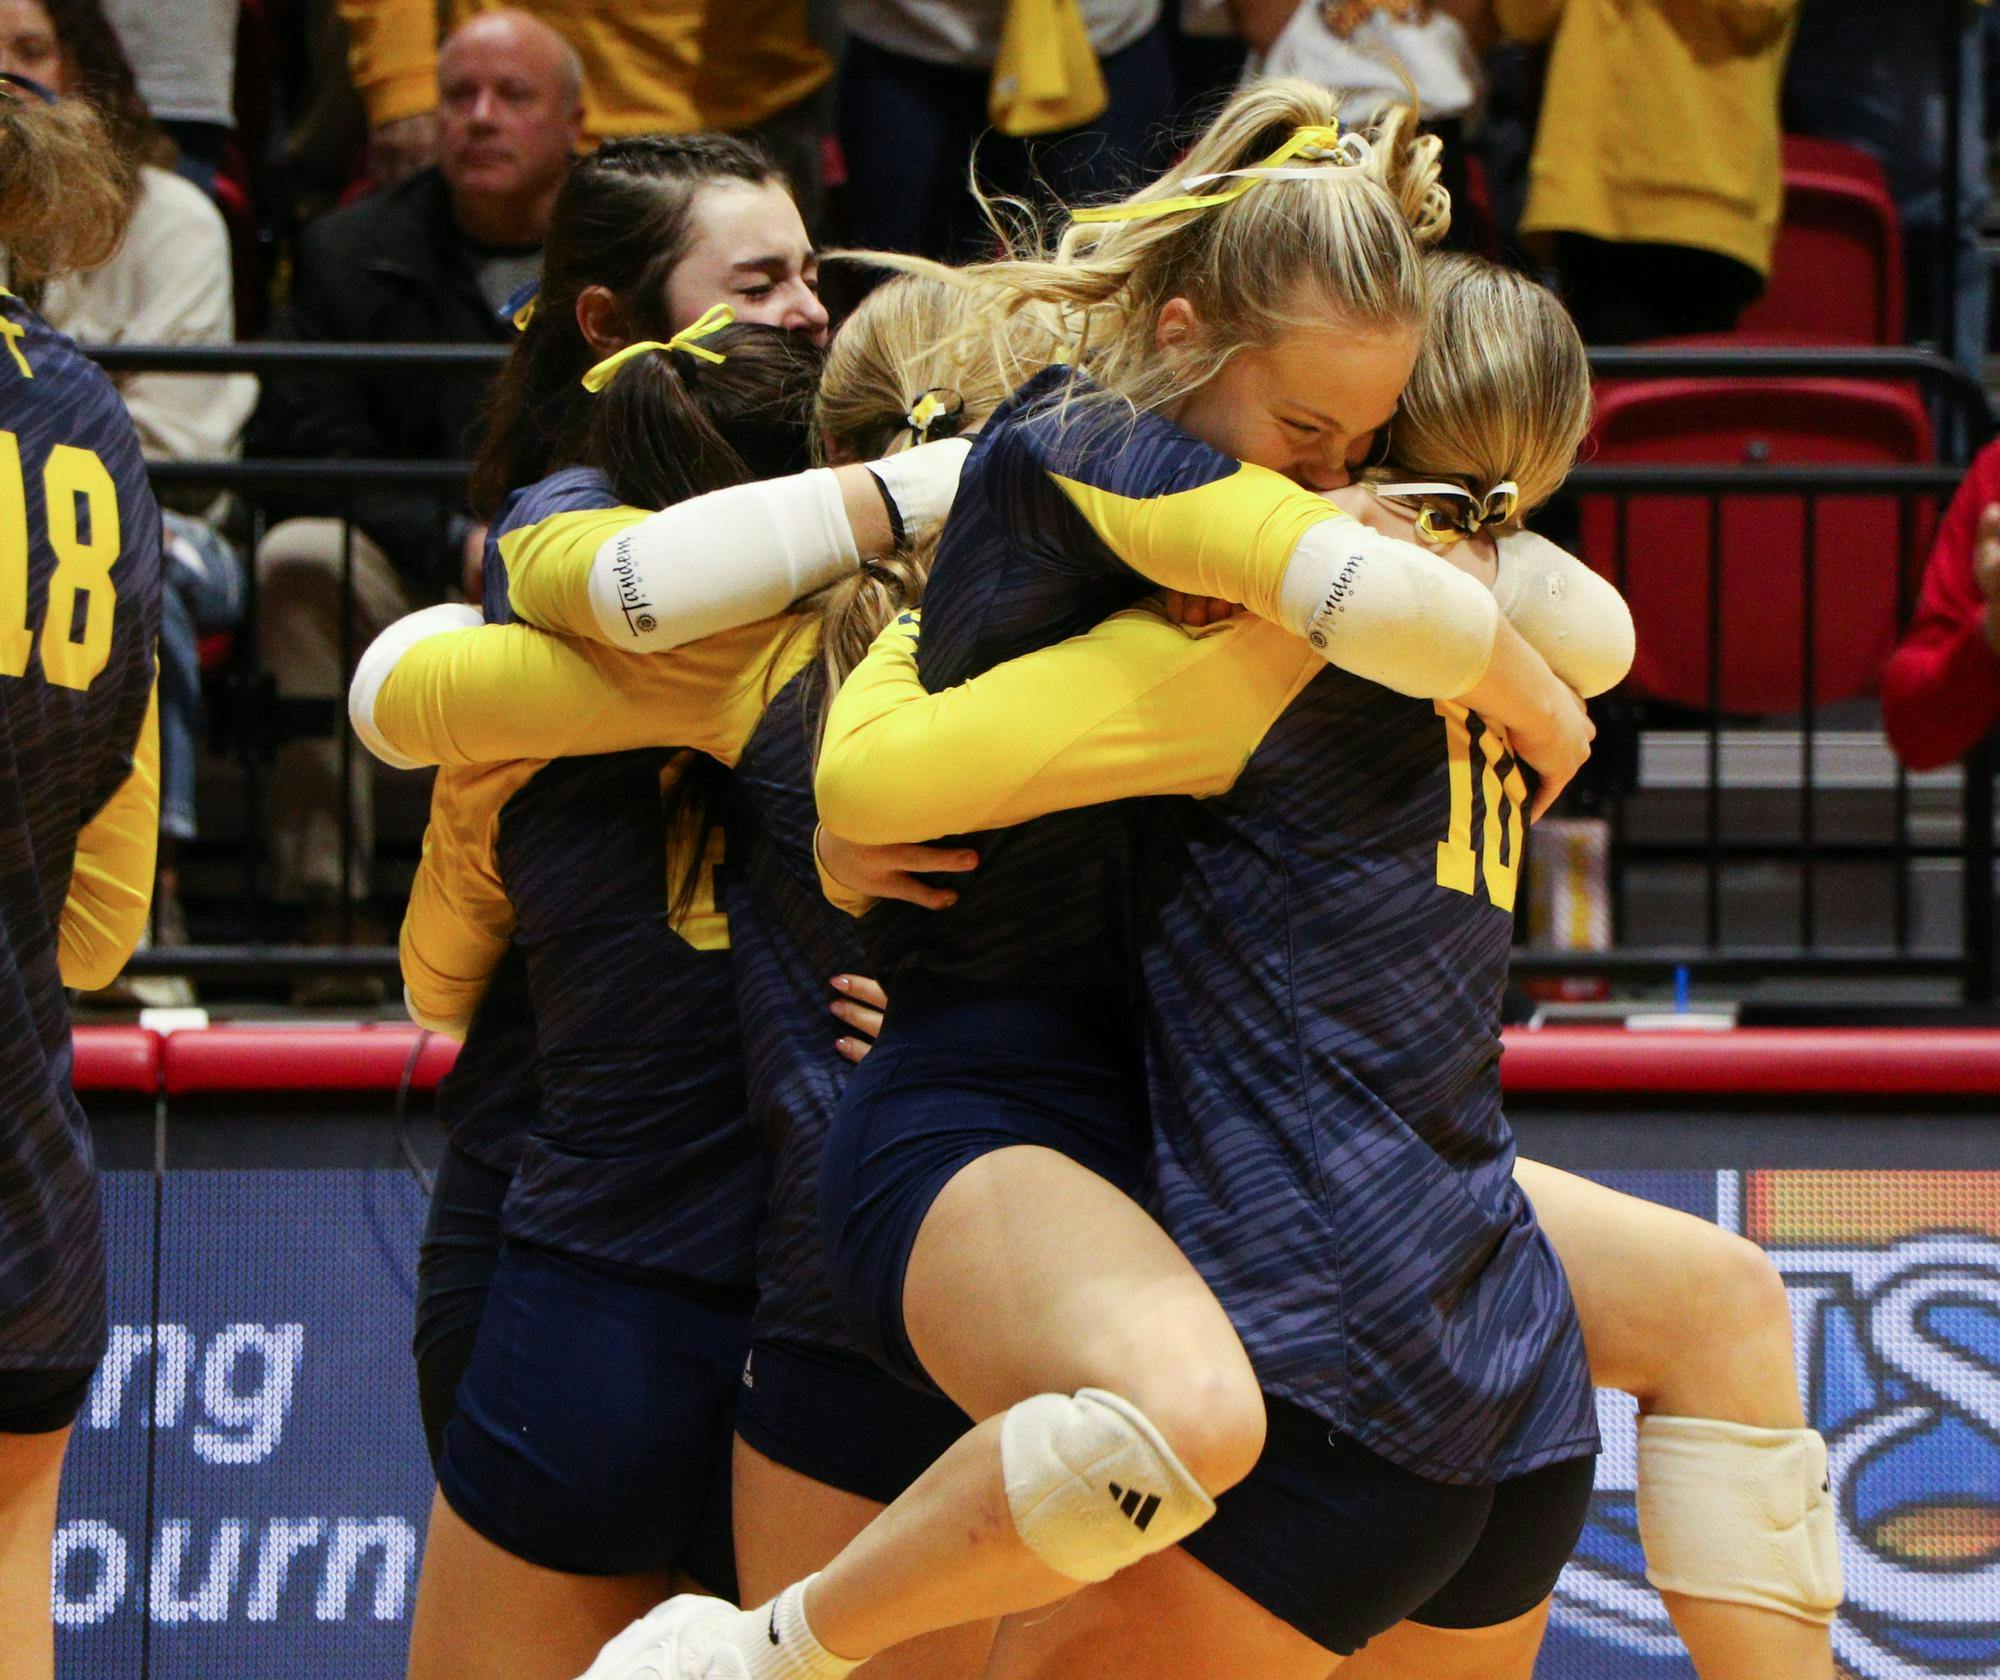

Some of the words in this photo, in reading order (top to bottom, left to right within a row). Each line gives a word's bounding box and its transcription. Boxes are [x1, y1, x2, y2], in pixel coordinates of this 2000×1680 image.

[0, 430, 120, 691] 18
[612, 536, 653, 637] Tandem
[1433, 699, 1527, 912] 10
[51, 1518, 416, 1630] ourn
